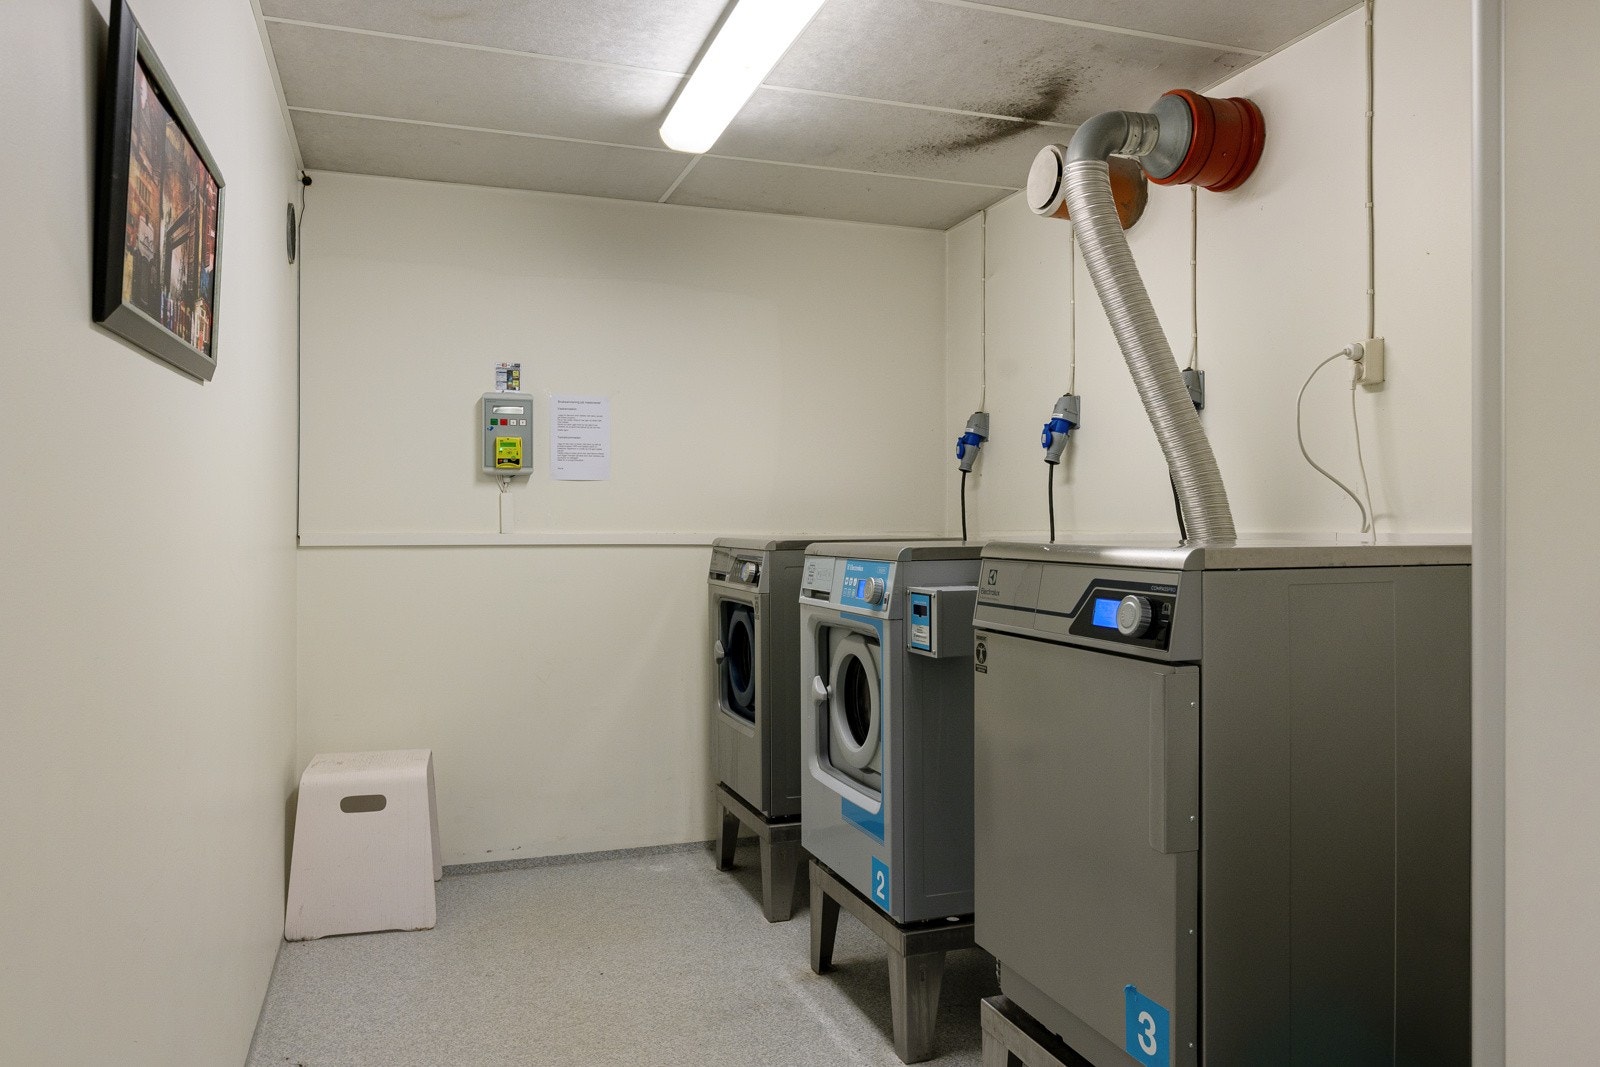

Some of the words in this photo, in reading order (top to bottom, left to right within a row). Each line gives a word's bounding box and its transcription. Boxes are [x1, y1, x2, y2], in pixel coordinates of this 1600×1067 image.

[980, 587, 1000, 597] Electrolux
[876, 870, 885, 900] 2
[1137, 1010, 1158, 1056] 3
